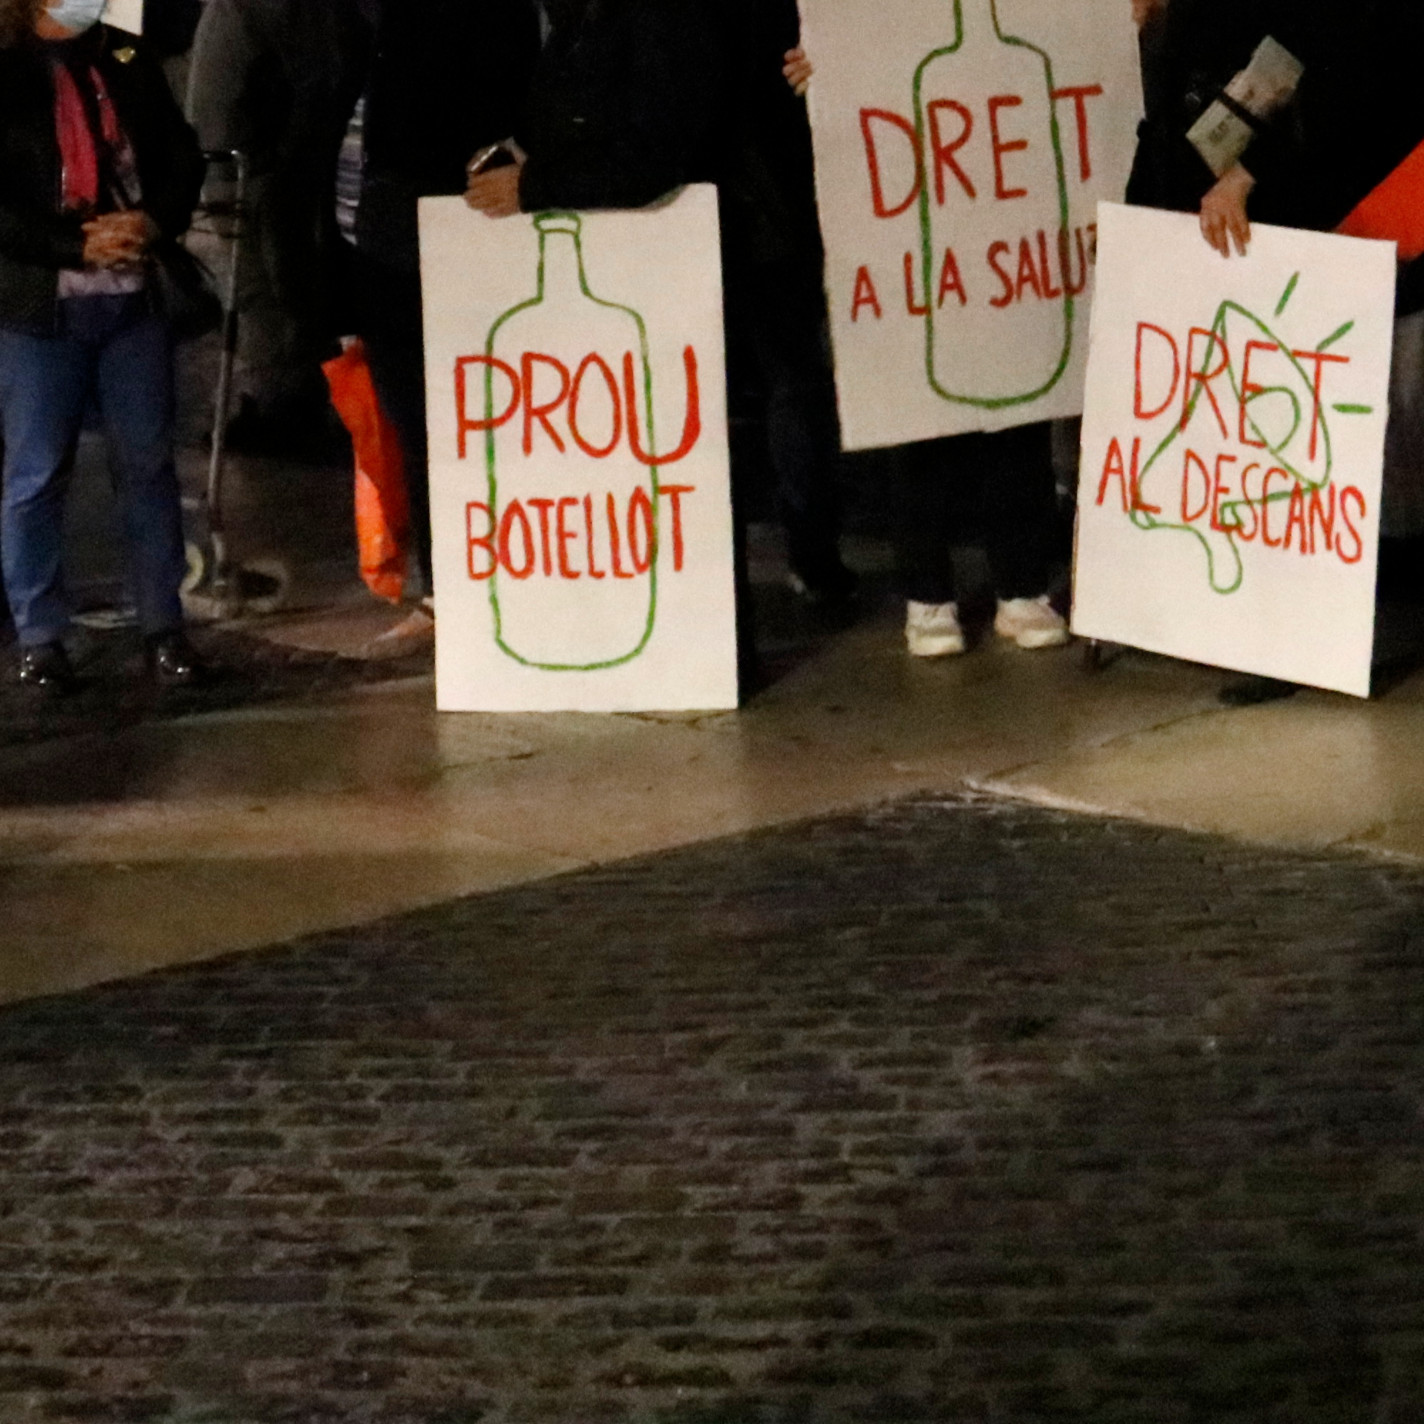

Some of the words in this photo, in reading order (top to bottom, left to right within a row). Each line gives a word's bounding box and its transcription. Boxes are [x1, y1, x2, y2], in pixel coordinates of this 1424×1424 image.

[858, 83, 1104, 220] DRET
[850, 264, 883, 323] A
[904, 250, 967, 317] LA
[453, 344, 701, 466] PROU
[1133, 323, 1350, 462] DRET
[463, 484, 696, 582] BOTELLOT
[1095, 435, 1163, 514] AL
[1180, 448, 1367, 565] DESCANS
